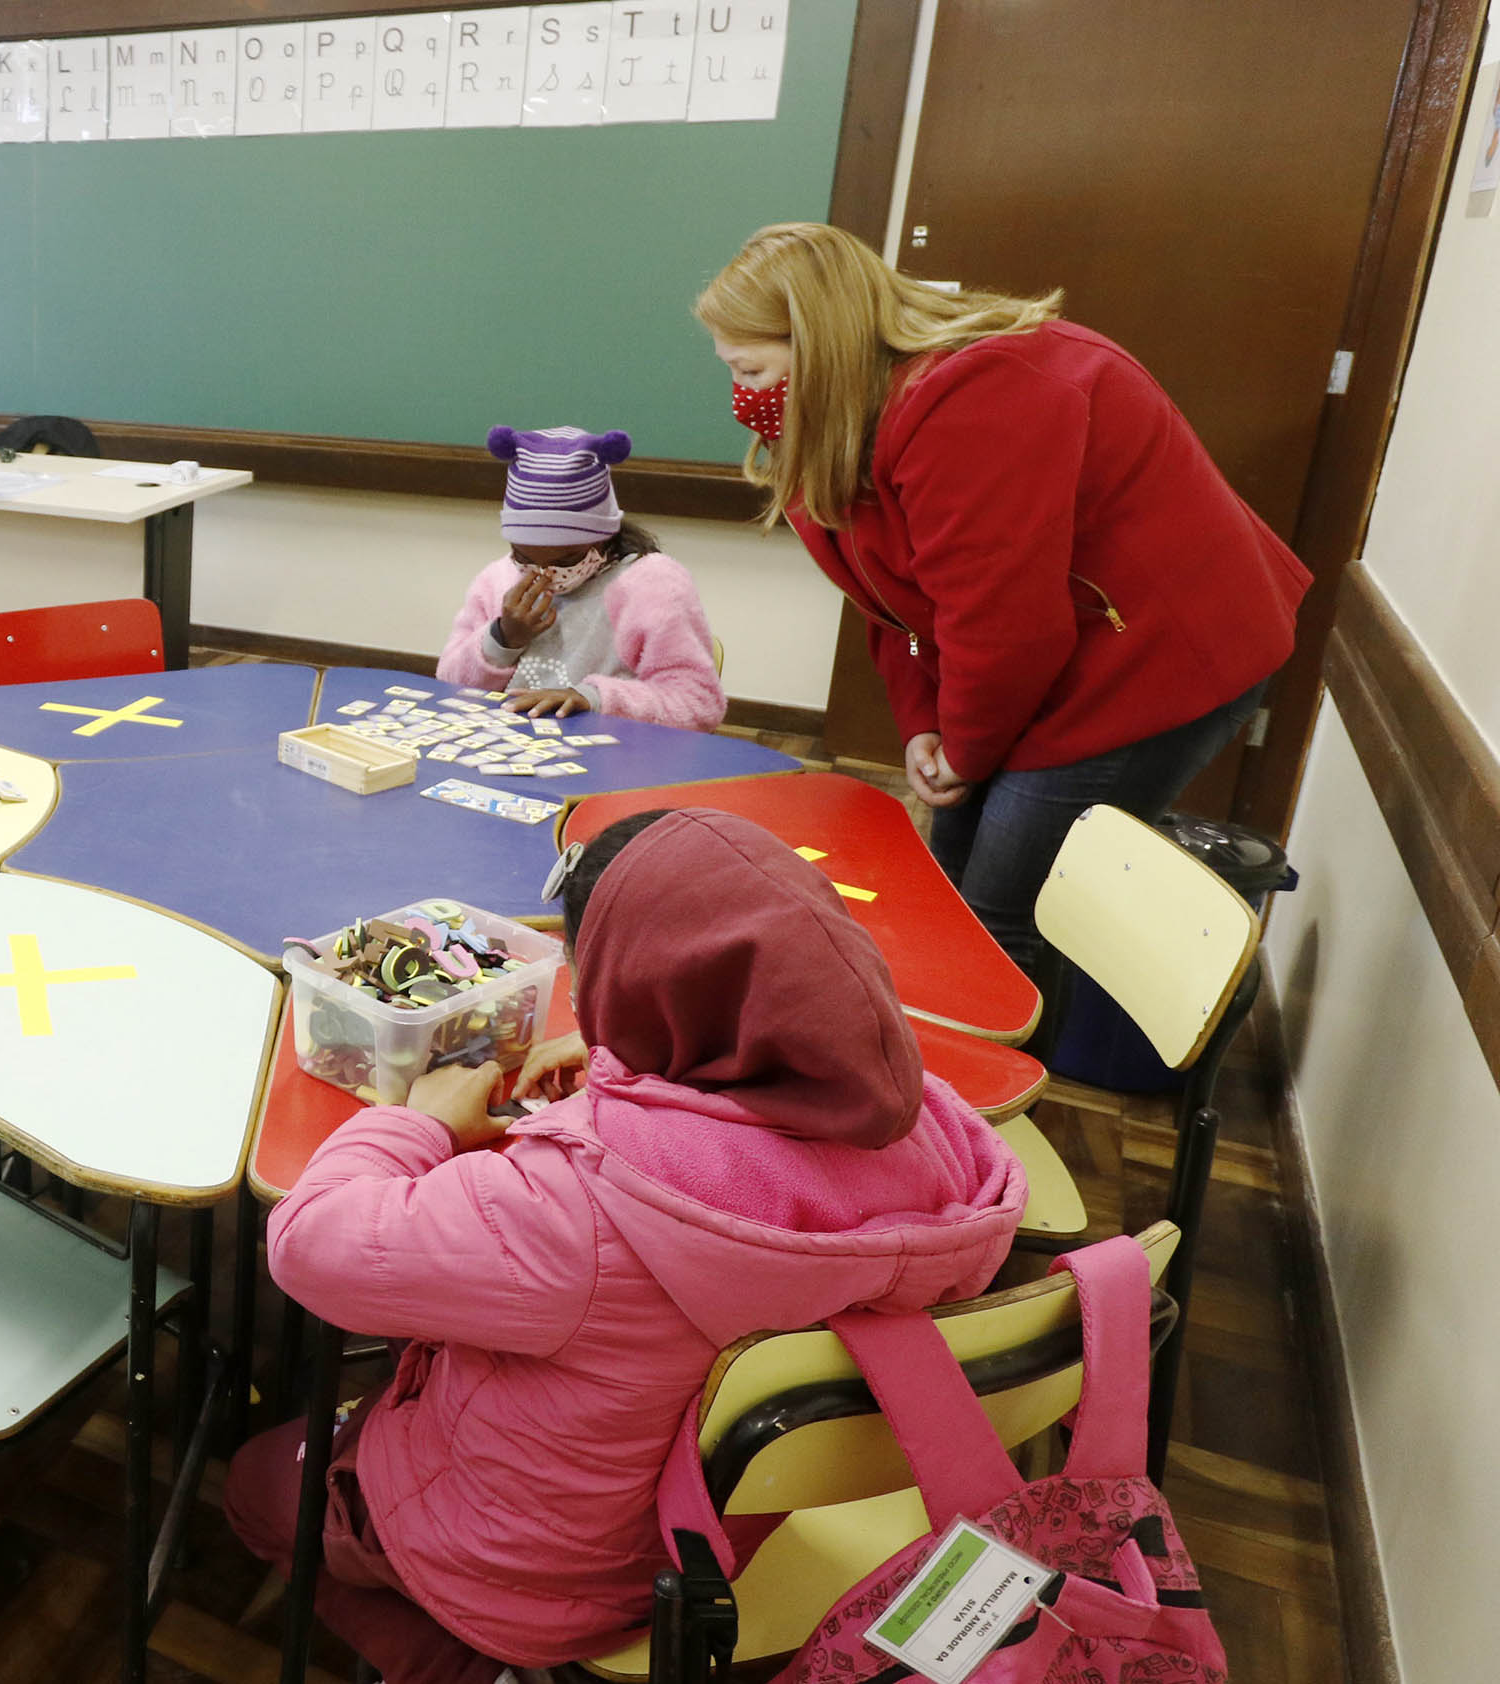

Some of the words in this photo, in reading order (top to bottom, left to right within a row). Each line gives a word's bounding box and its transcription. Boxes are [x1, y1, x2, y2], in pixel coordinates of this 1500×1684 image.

[541, 18, 560, 45] S
[587, 25, 599, 42] s
[623, 10, 643, 37] T
[673, 13, 681, 36] t
[710, 7, 731, 33] U
[761, 16, 773, 31] u
[317, 32, 335, 57] P
[356, 41, 366, 60] p
[383, 27, 404, 52] Q
[426, 37, 437, 58] q
[460, 22, 479, 47] R
[507, 30, 514, 44] r
[57, 51, 71, 73] L
[116, 45, 133, 66] M
[150, 51, 164, 65] m
[180, 41, 197, 65] N
[216, 49, 226, 63] n
[244, 38, 263, 60] O
[284, 43, 295, 58] o
[460, 62, 479, 93] R
[707, 55, 728, 82] U
[319, 72, 335, 100] P
[953, 1598, 976, 1622] SILVA
[946, 1614, 980, 1652] ANDRADE
[975, 1620, 992, 1637] ANO
[935, 1651, 949, 1662] DA
